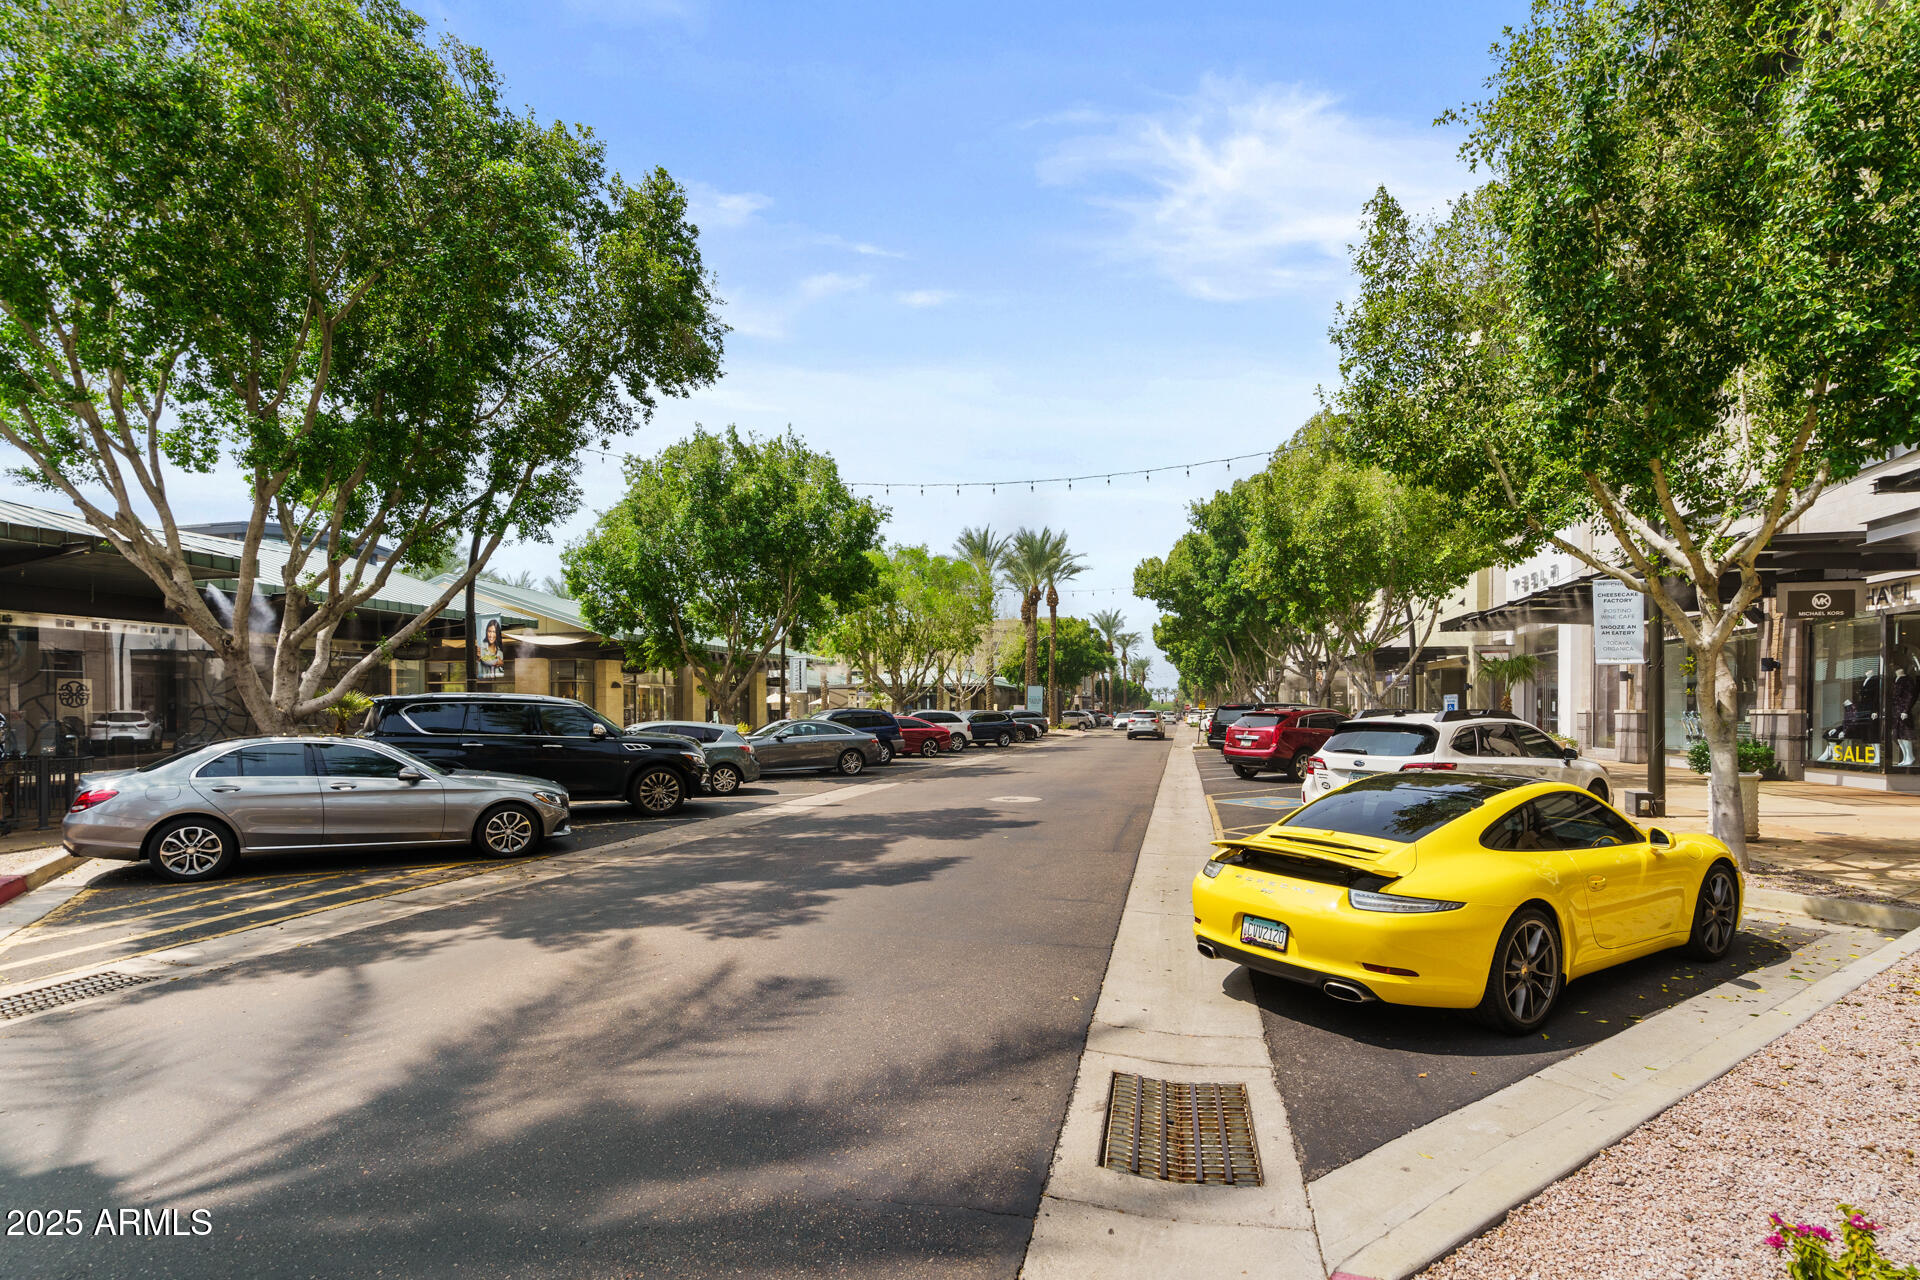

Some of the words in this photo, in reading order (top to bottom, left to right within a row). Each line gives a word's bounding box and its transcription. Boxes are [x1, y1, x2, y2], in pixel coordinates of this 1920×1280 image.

[1513, 564, 1560, 592] TESLA
[1833, 745, 1876, 763] SALE
[1247, 922, 1284, 944] CVV2120
